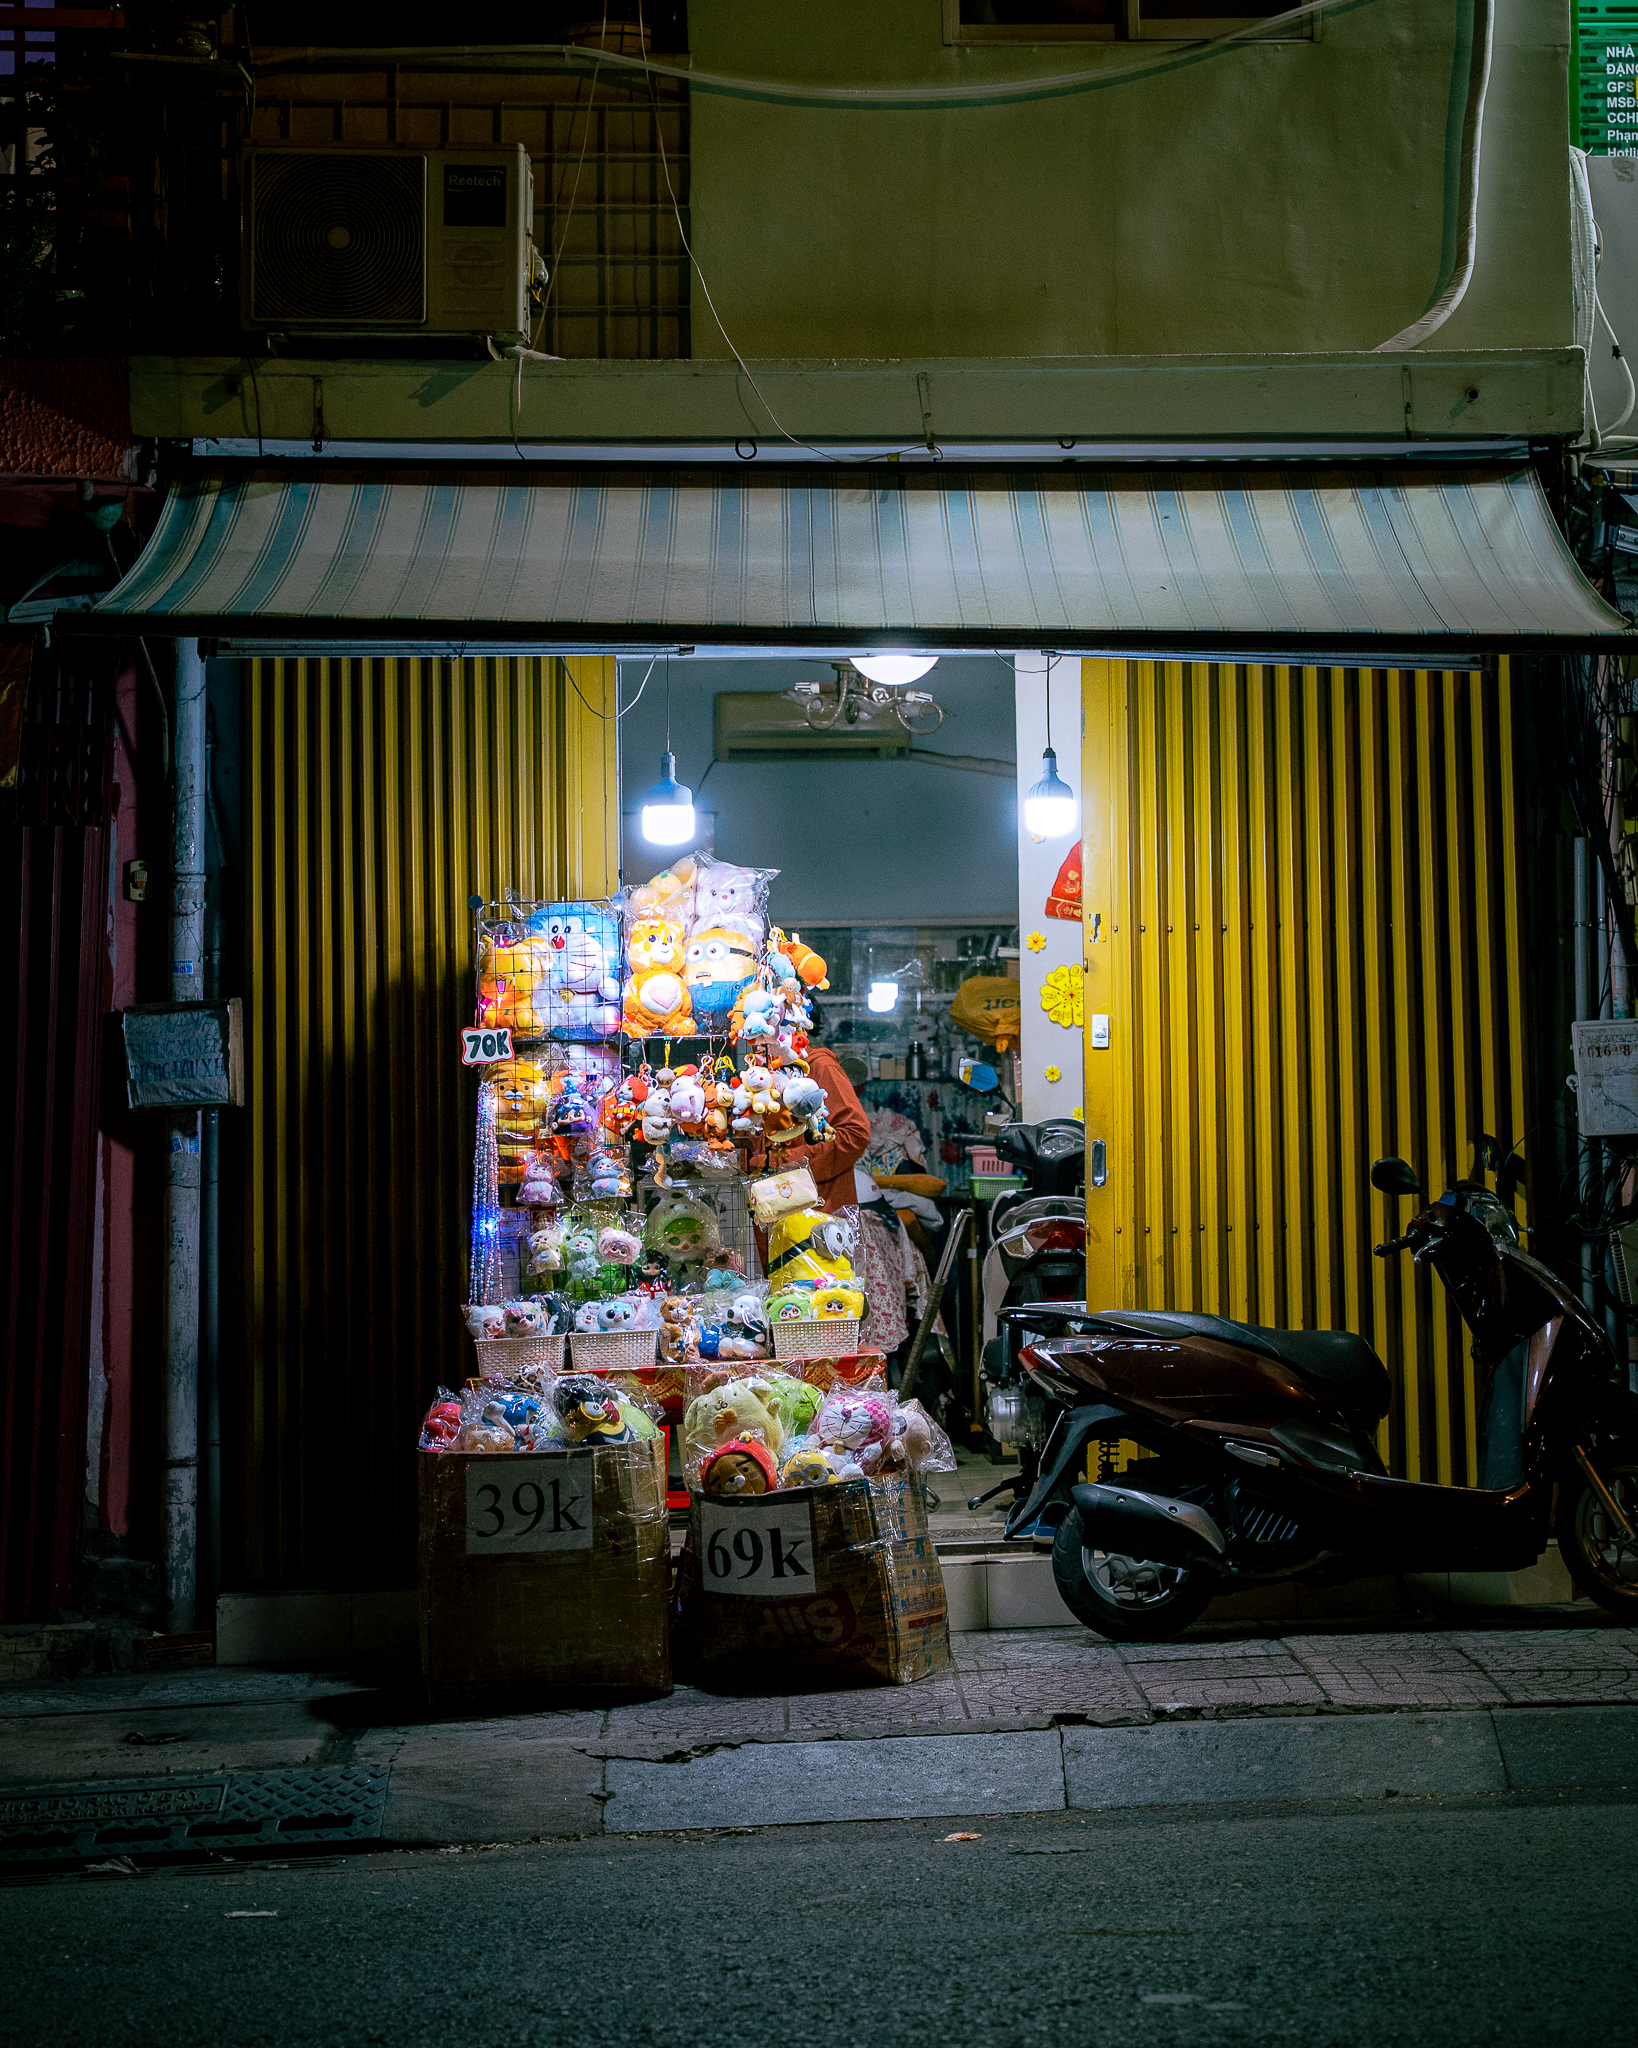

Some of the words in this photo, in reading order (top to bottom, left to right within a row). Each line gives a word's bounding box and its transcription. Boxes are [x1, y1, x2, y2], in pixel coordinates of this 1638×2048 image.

[1606, 44, 1635, 58] NHÀ
[1607, 81, 1635, 93] GPS
[1607, 97, 1638, 108] MSĐ
[449, 174, 501, 186] Reetech
[466, 1030, 510, 1059] 70K
[476, 1478, 587, 1538] 39k
[707, 1527, 811, 1580] 69k
